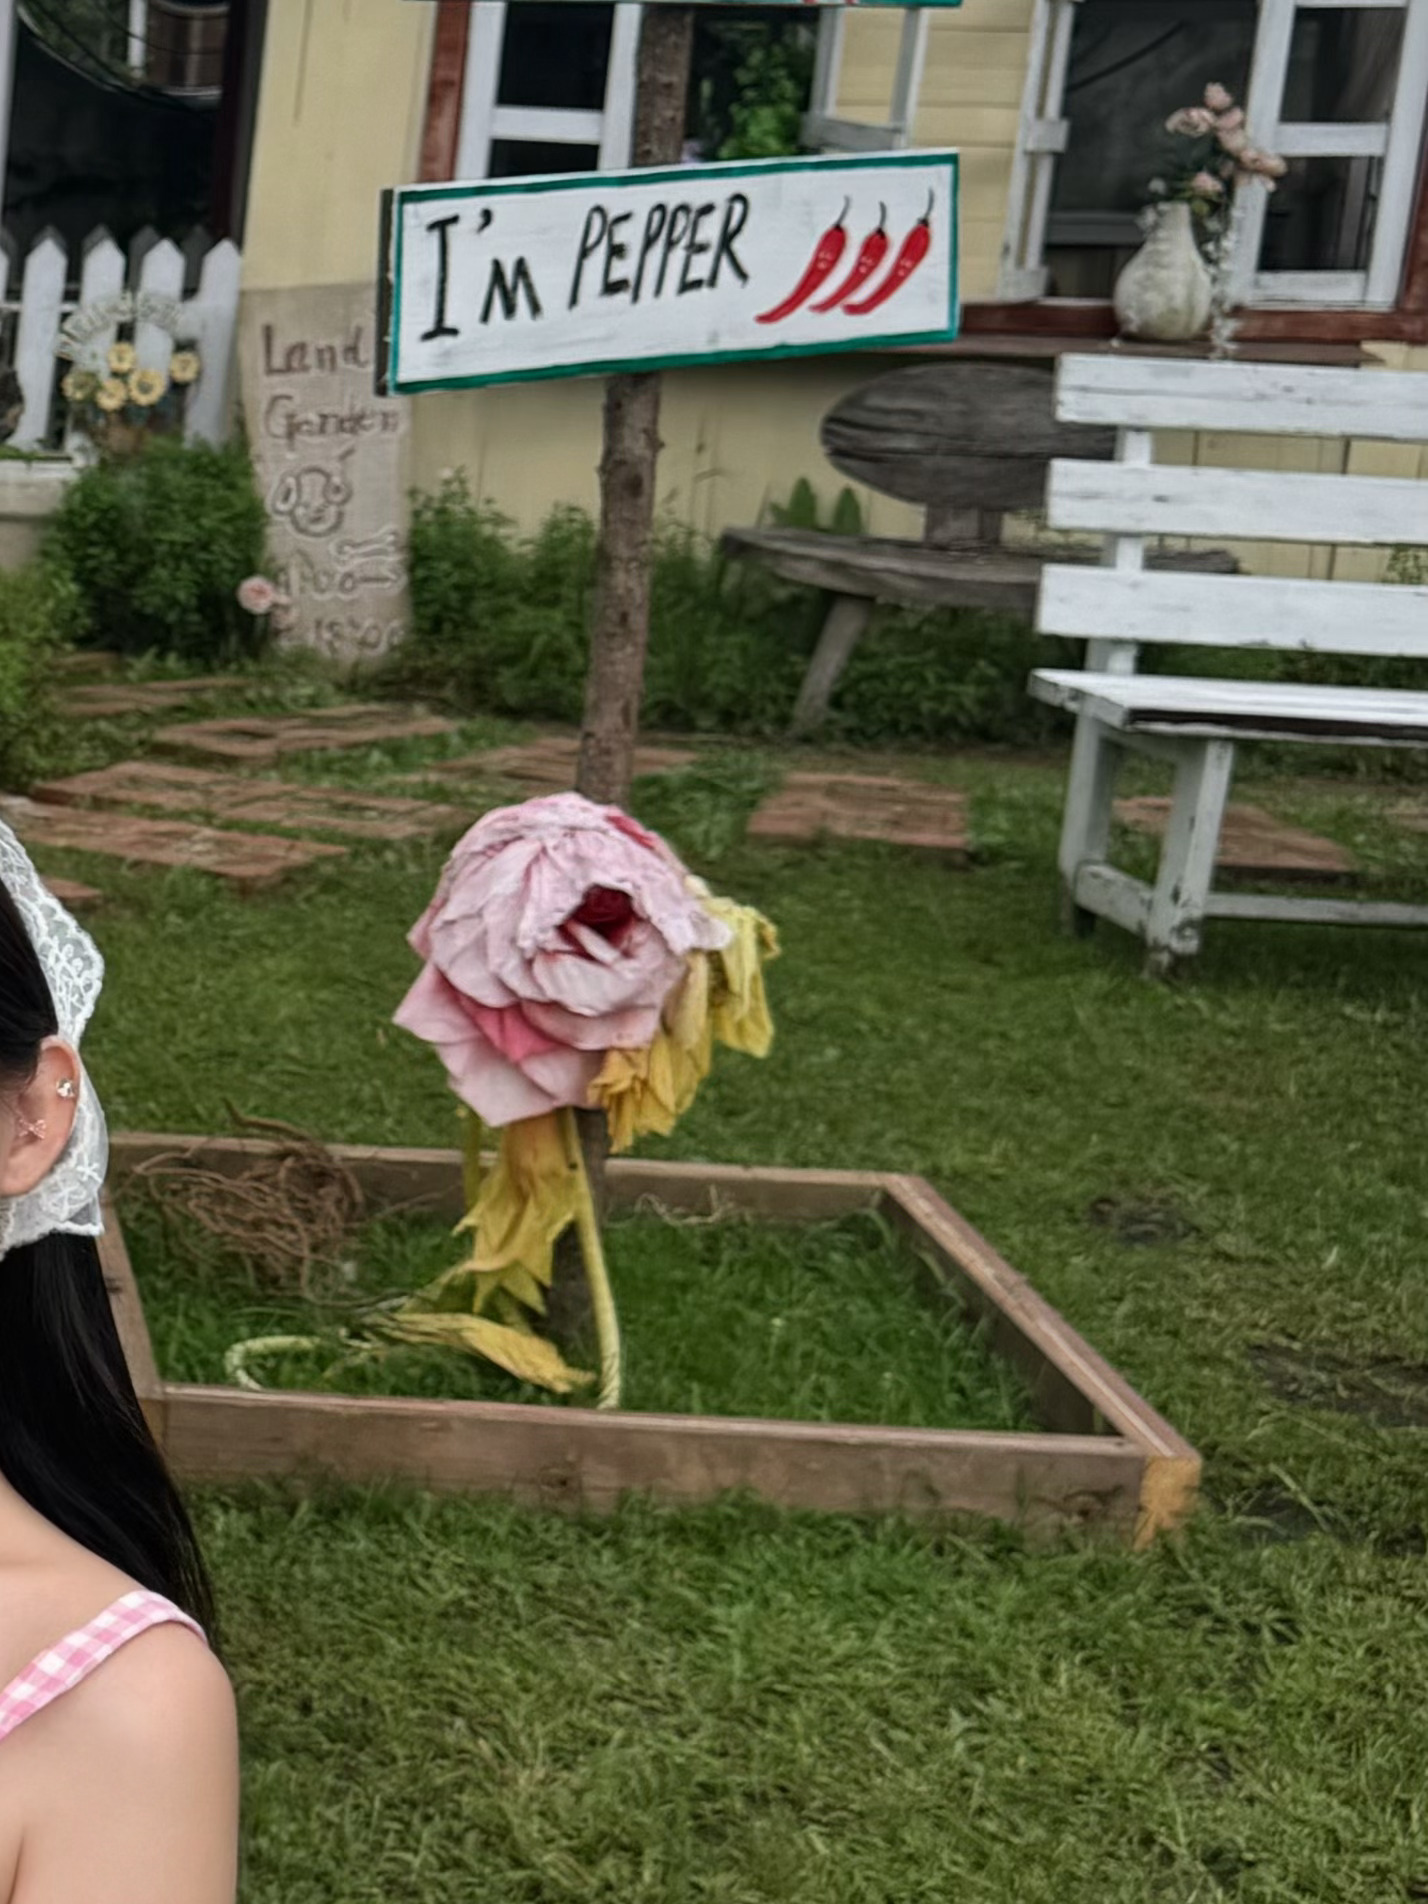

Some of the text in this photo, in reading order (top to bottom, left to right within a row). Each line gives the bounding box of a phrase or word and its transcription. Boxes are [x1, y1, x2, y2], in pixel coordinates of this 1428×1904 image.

[567, 192, 751, 311] PEPPER
[262, 323, 371, 378] Land
[262, 393, 401, 450] Garden
